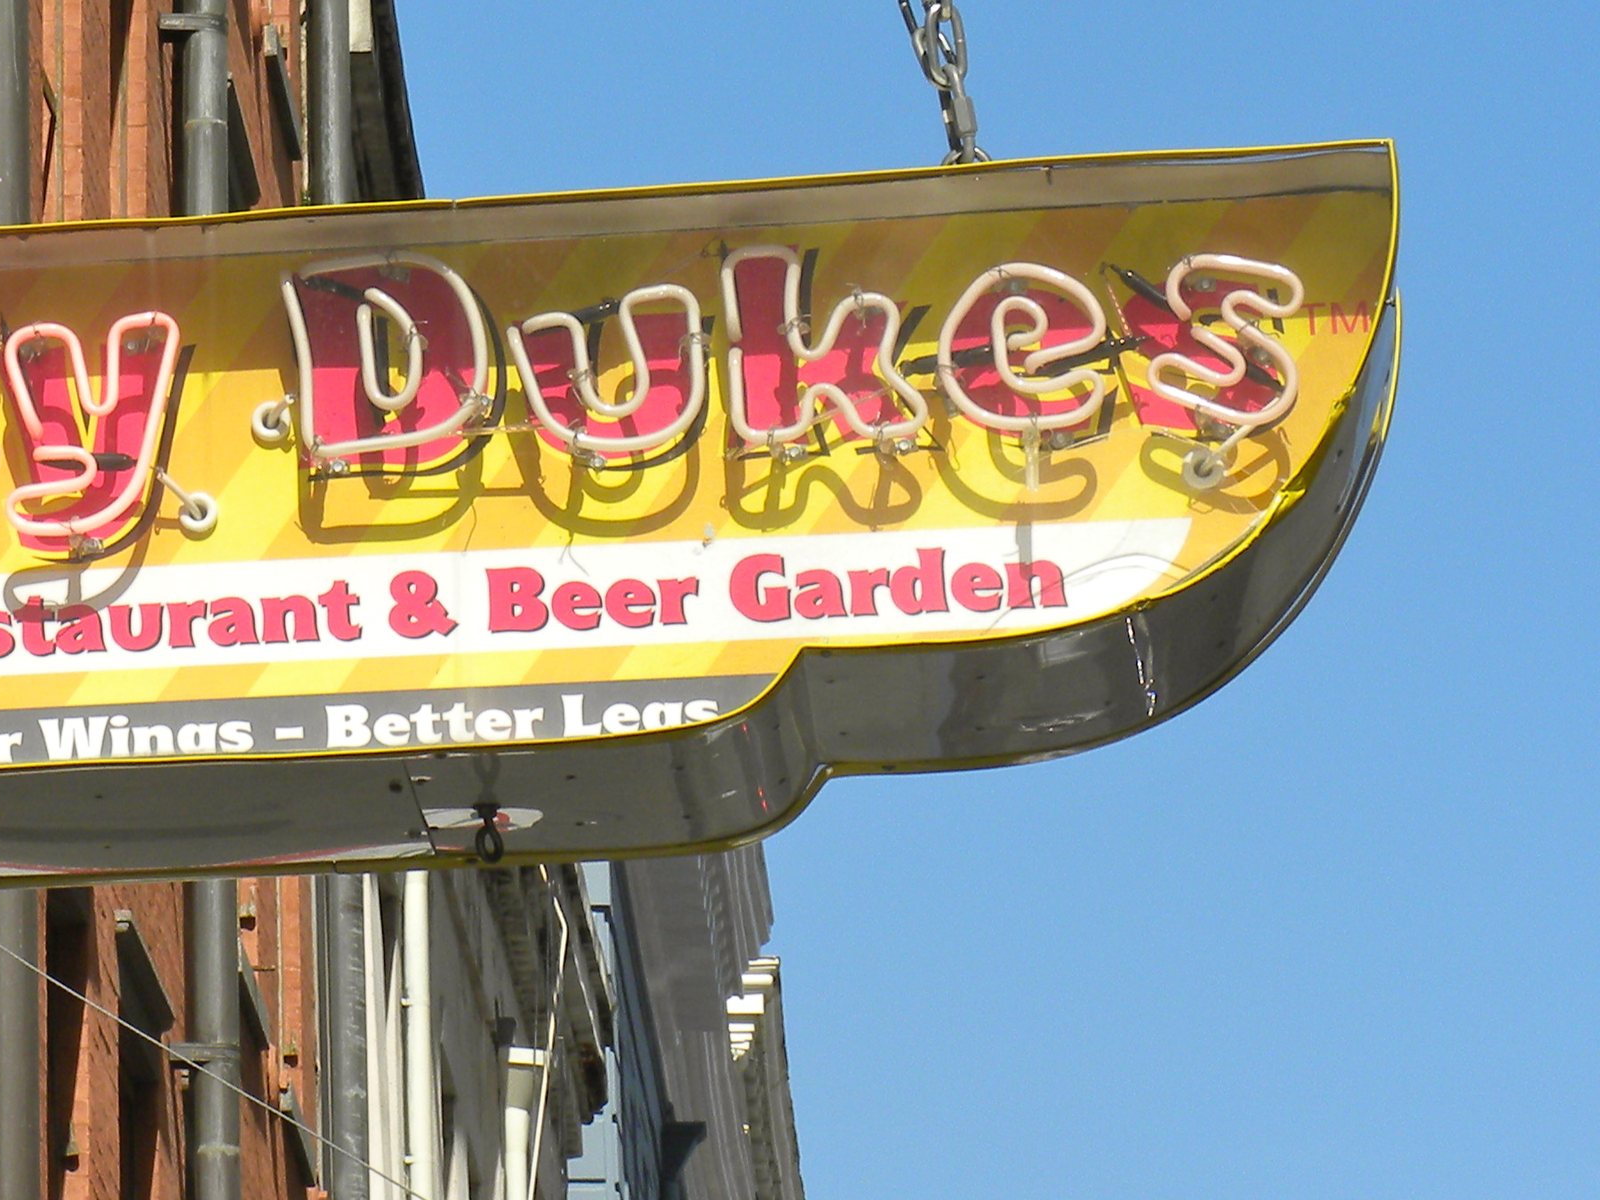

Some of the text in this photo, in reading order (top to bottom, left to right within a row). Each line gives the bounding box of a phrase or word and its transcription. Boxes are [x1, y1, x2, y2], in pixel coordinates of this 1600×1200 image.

[1302, 302, 1371, 336] TM
[281, 244, 1304, 481] Dukes
[389, 569, 458, 638] &
[485, 565, 699, 633] Beer
[729, 546, 1069, 623] Garden
[325, 701, 544, 749] Better
